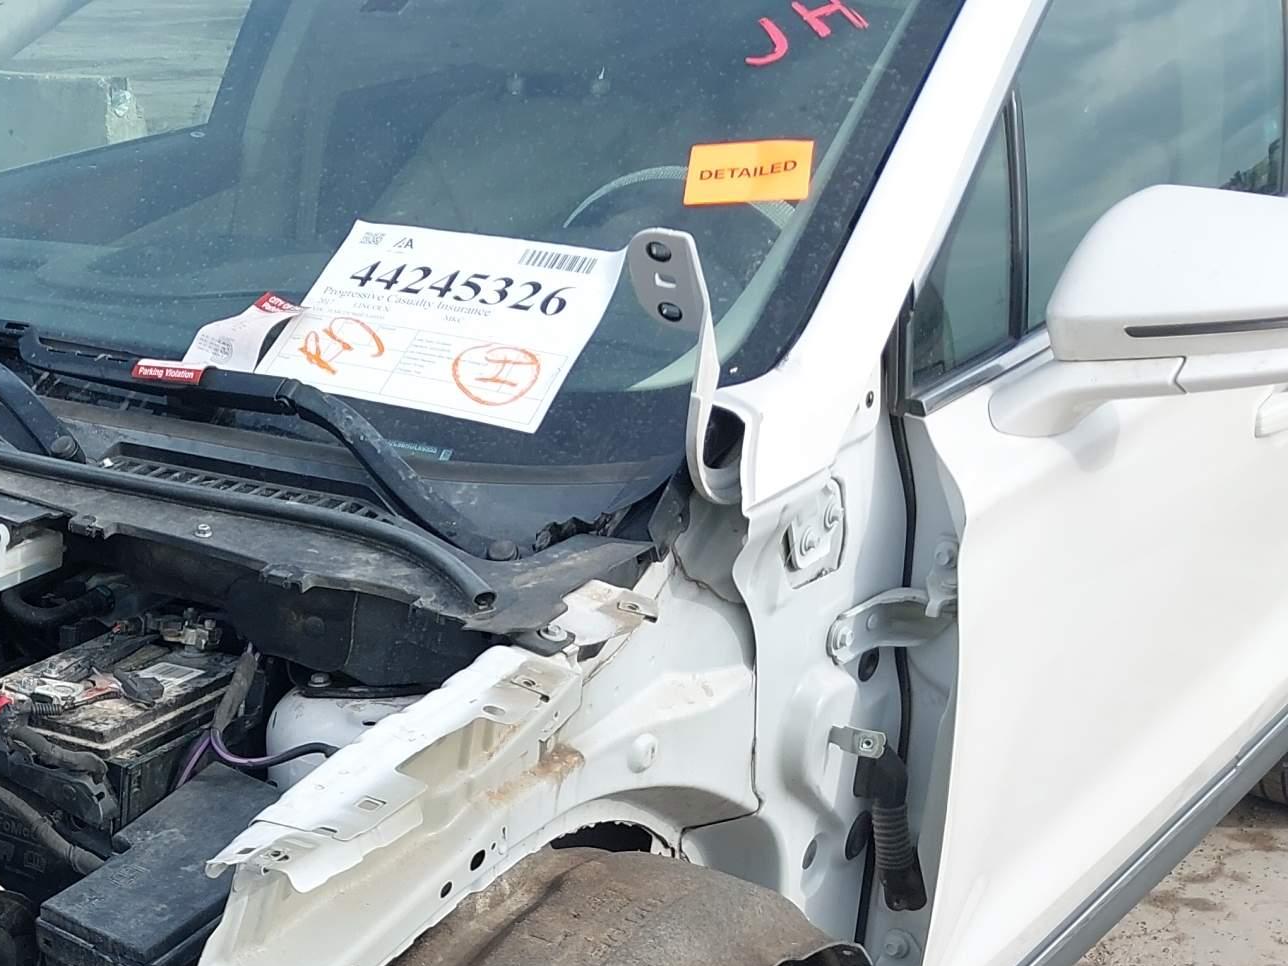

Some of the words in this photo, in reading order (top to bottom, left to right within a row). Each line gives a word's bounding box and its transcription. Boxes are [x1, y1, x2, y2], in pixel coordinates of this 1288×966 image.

[698, 159, 798, 181] DETAILED
[323, 286, 385, 301] Progressive
[386, 294, 434, 310] Casualty
[436, 301, 492, 316] Insurance
[349, 260, 575, 316] 44245326
[138, 367, 164, 379] Parking
[165, 368, 194, 379] Violation
